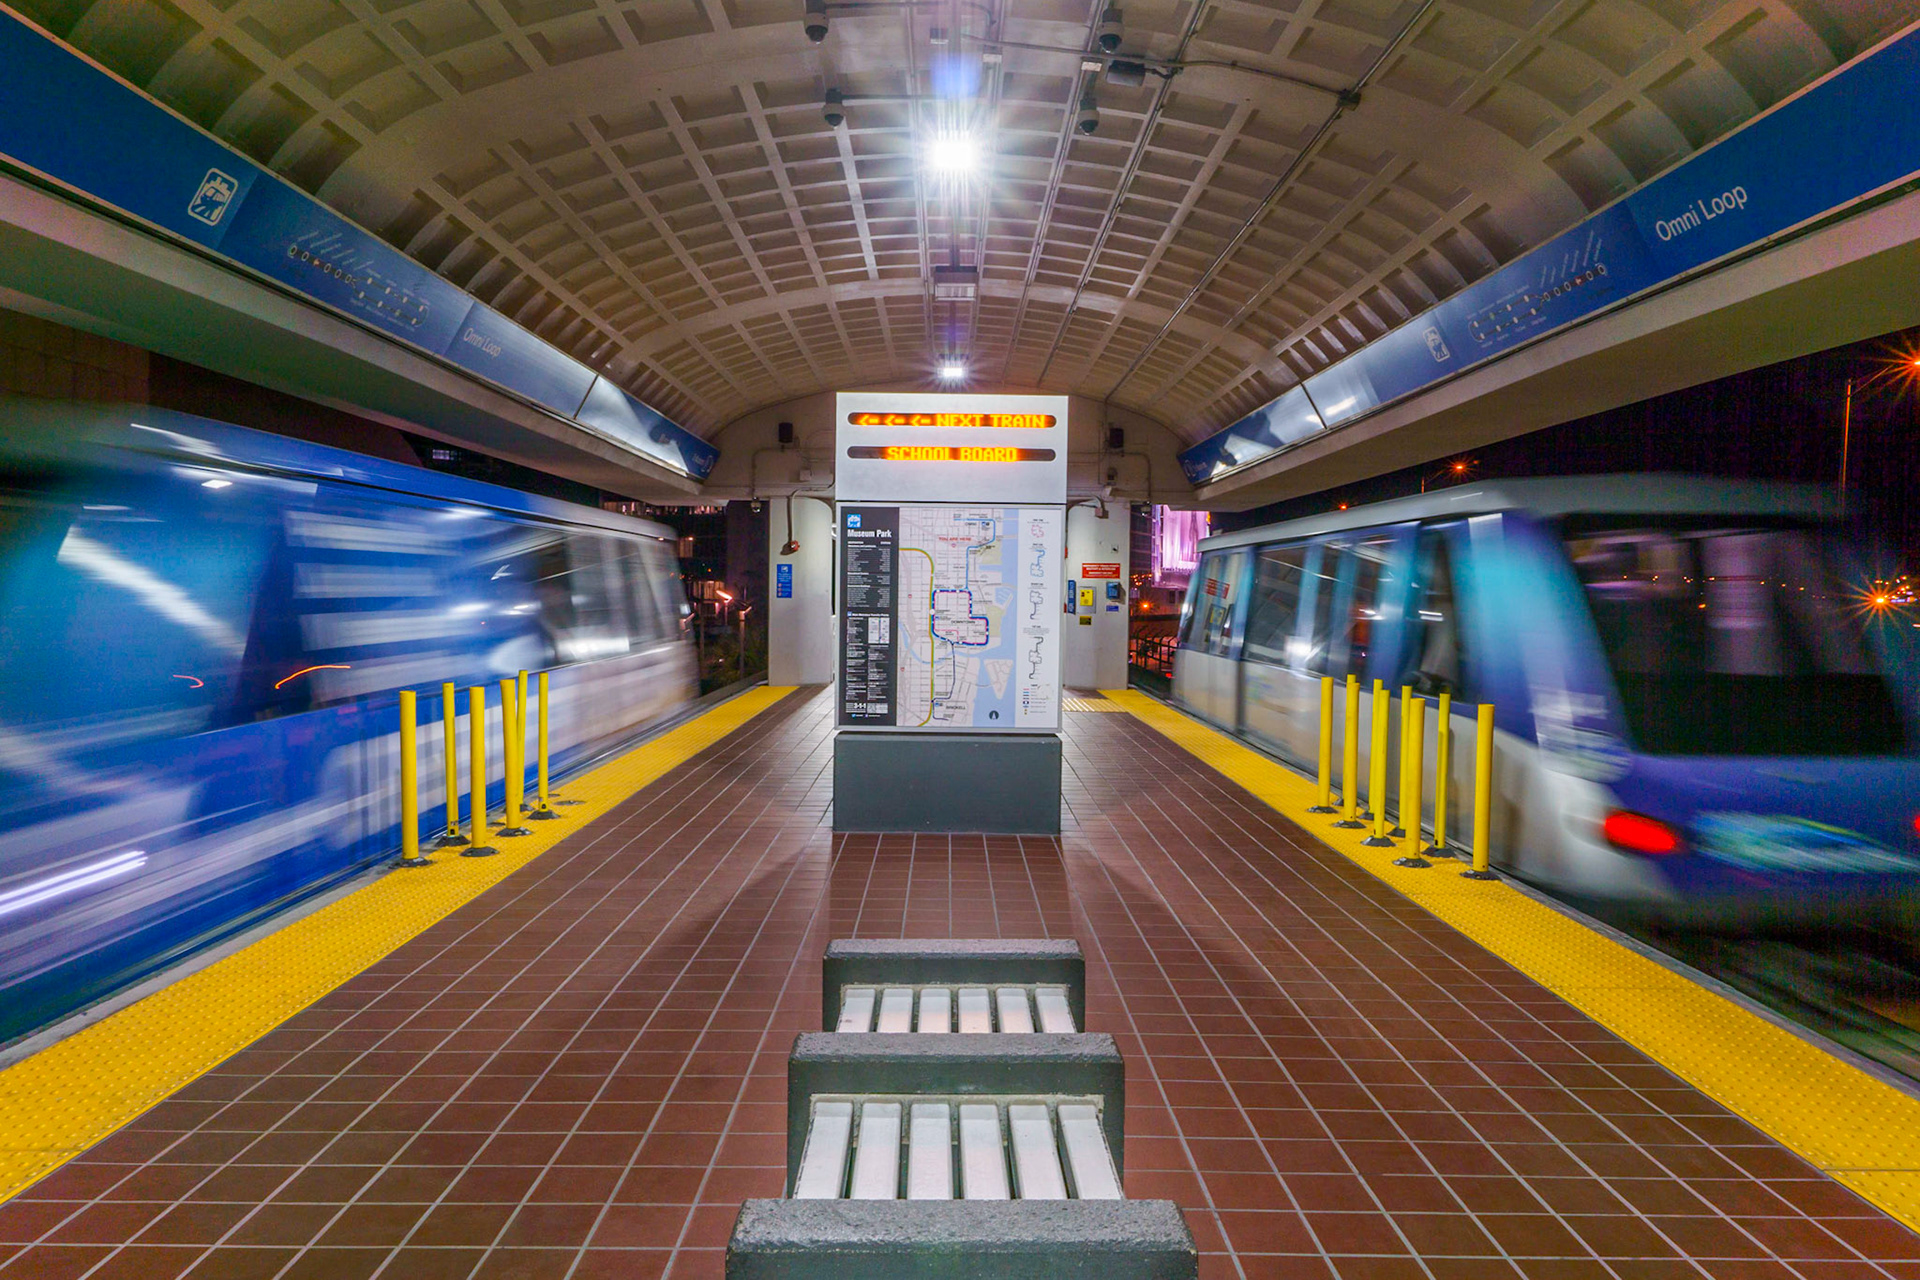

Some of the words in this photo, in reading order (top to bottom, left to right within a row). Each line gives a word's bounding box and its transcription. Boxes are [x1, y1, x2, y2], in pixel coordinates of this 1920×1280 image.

[1655, 204, 1702, 242] Omni
[1697, 185, 1748, 221] Loop
[936, 414, 984, 428] NEXT
[990, 414, 1046, 429] TRAIN
[886, 446, 953, 461] SCHOOL
[959, 447, 1019, 462] BOARD
[847, 529, 875, 538] Museum
[876, 529, 892, 538] Park
